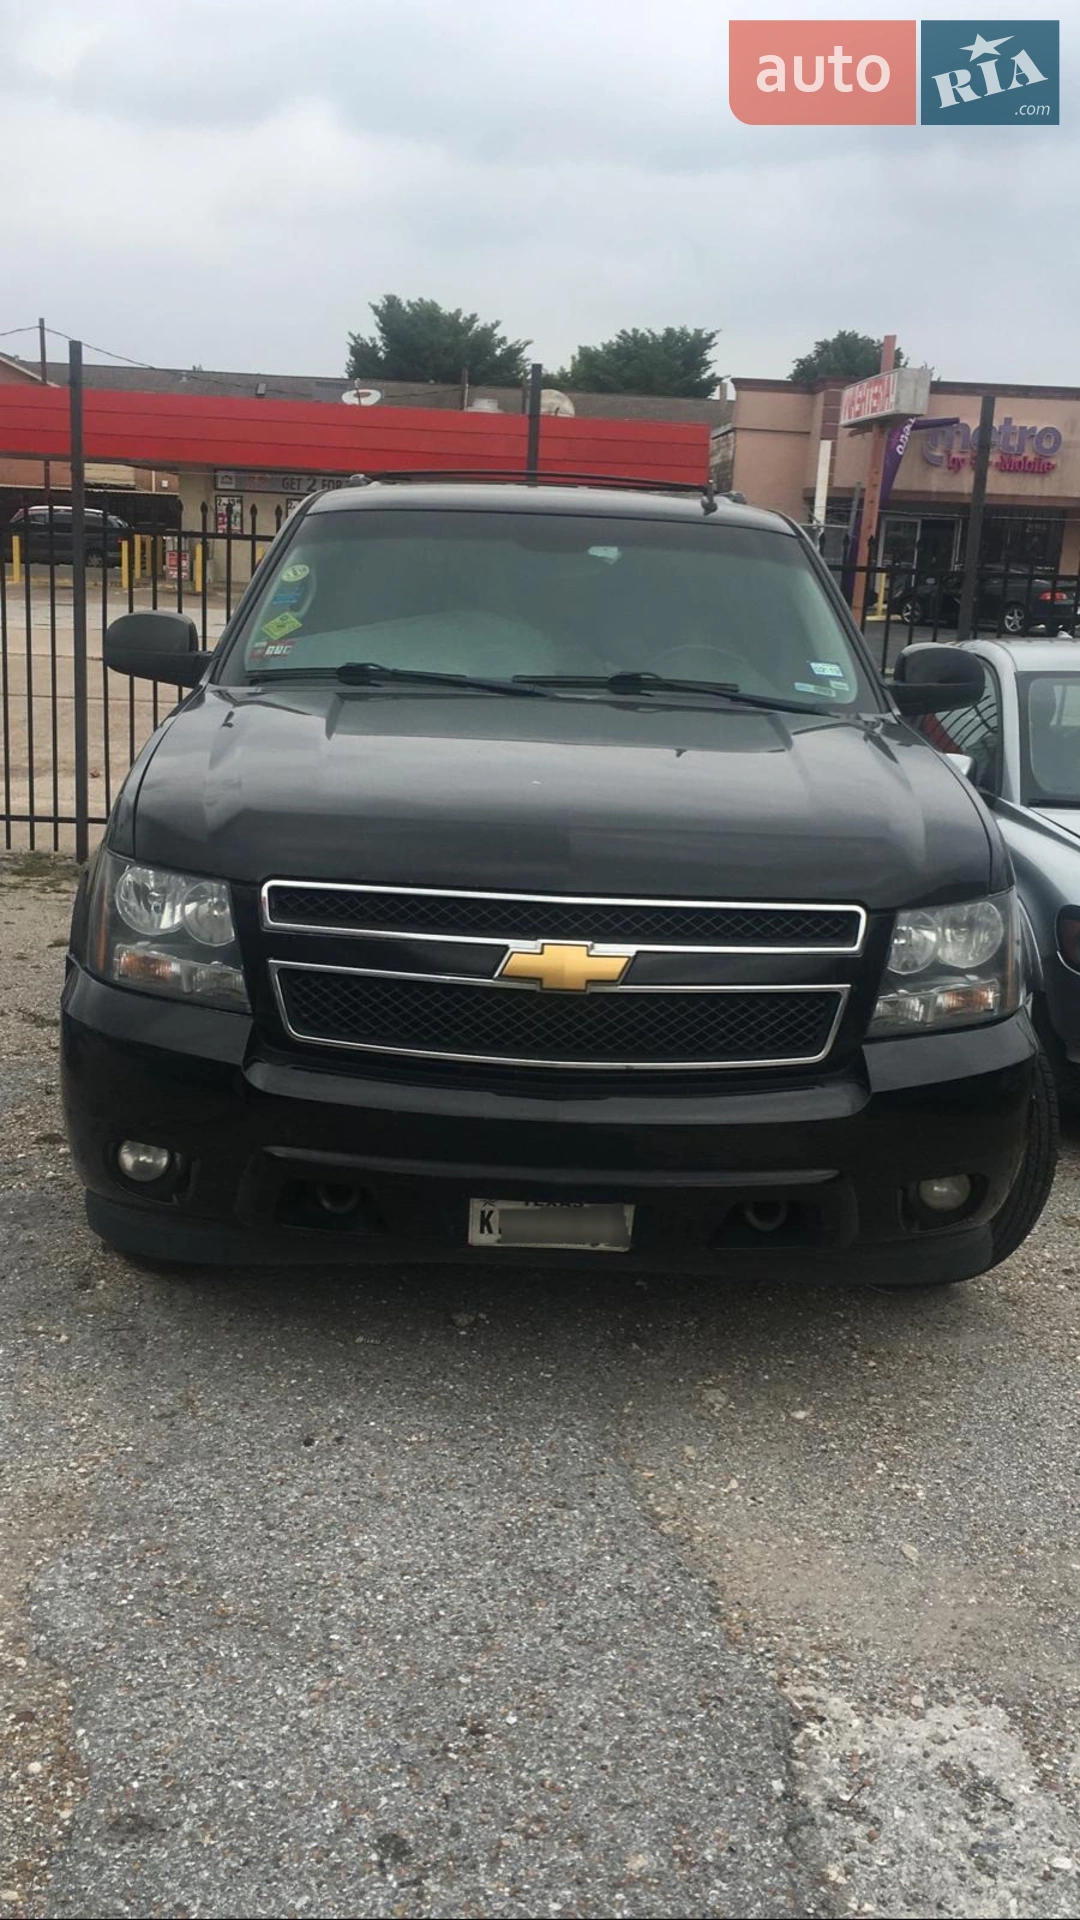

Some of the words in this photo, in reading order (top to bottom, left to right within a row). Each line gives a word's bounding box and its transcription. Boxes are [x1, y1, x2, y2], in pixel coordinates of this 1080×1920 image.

[281, 477, 301, 491] GET
[306, 478, 317, 492] 2
[321, 479, 343, 490] FOR
